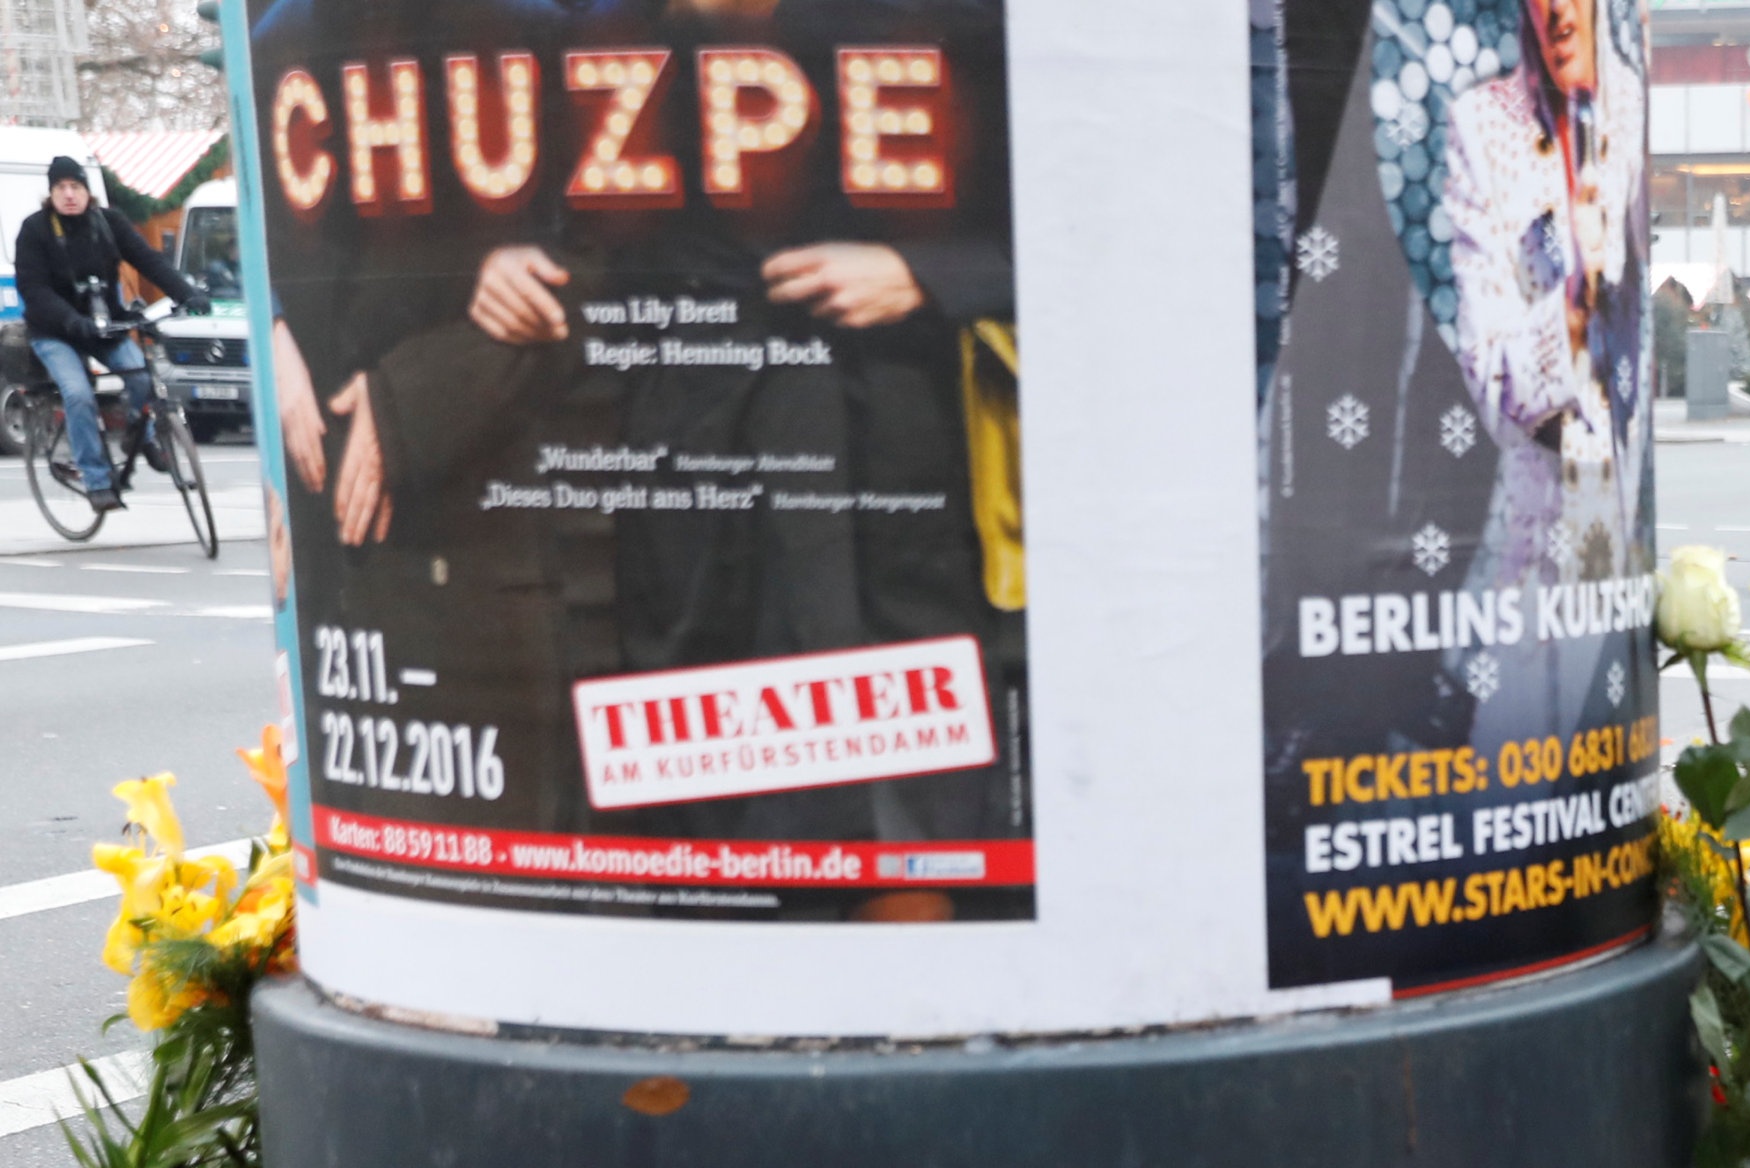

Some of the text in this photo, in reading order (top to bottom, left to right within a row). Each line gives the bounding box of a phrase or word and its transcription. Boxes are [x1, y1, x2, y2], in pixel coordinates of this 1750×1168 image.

[272, 44, 955, 217] CHUZPE
[583, 299, 739, 329] von Lily Brett
[586, 337, 832, 371] Regie: Henning Bock
[554, 484, 598, 509] Duo
[602, 484, 650, 514] geht
[652, 489, 694, 509] ans
[1299, 573, 1656, 658] BERLINS KULTSHO
[590, 664, 964, 751] THEATER
[321, 710, 505, 801] 22.12.2016
[601, 721, 971, 786] AM KURFÜRSTENDAMM
[1302, 746, 1488, 806] TICKETS:
[1498, 735, 1563, 788] 030
[1568, 724, 1625, 778] 6831
[329, 815, 380, 851] Karten:
[512, 839, 861, 880] www.komoedie-berlin.de
[1304, 813, 1463, 874] ESTREL
[1473, 788, 1606, 856] FESTIVAL
[1304, 832, 1657, 939] WWW.STARS-IN-CON
